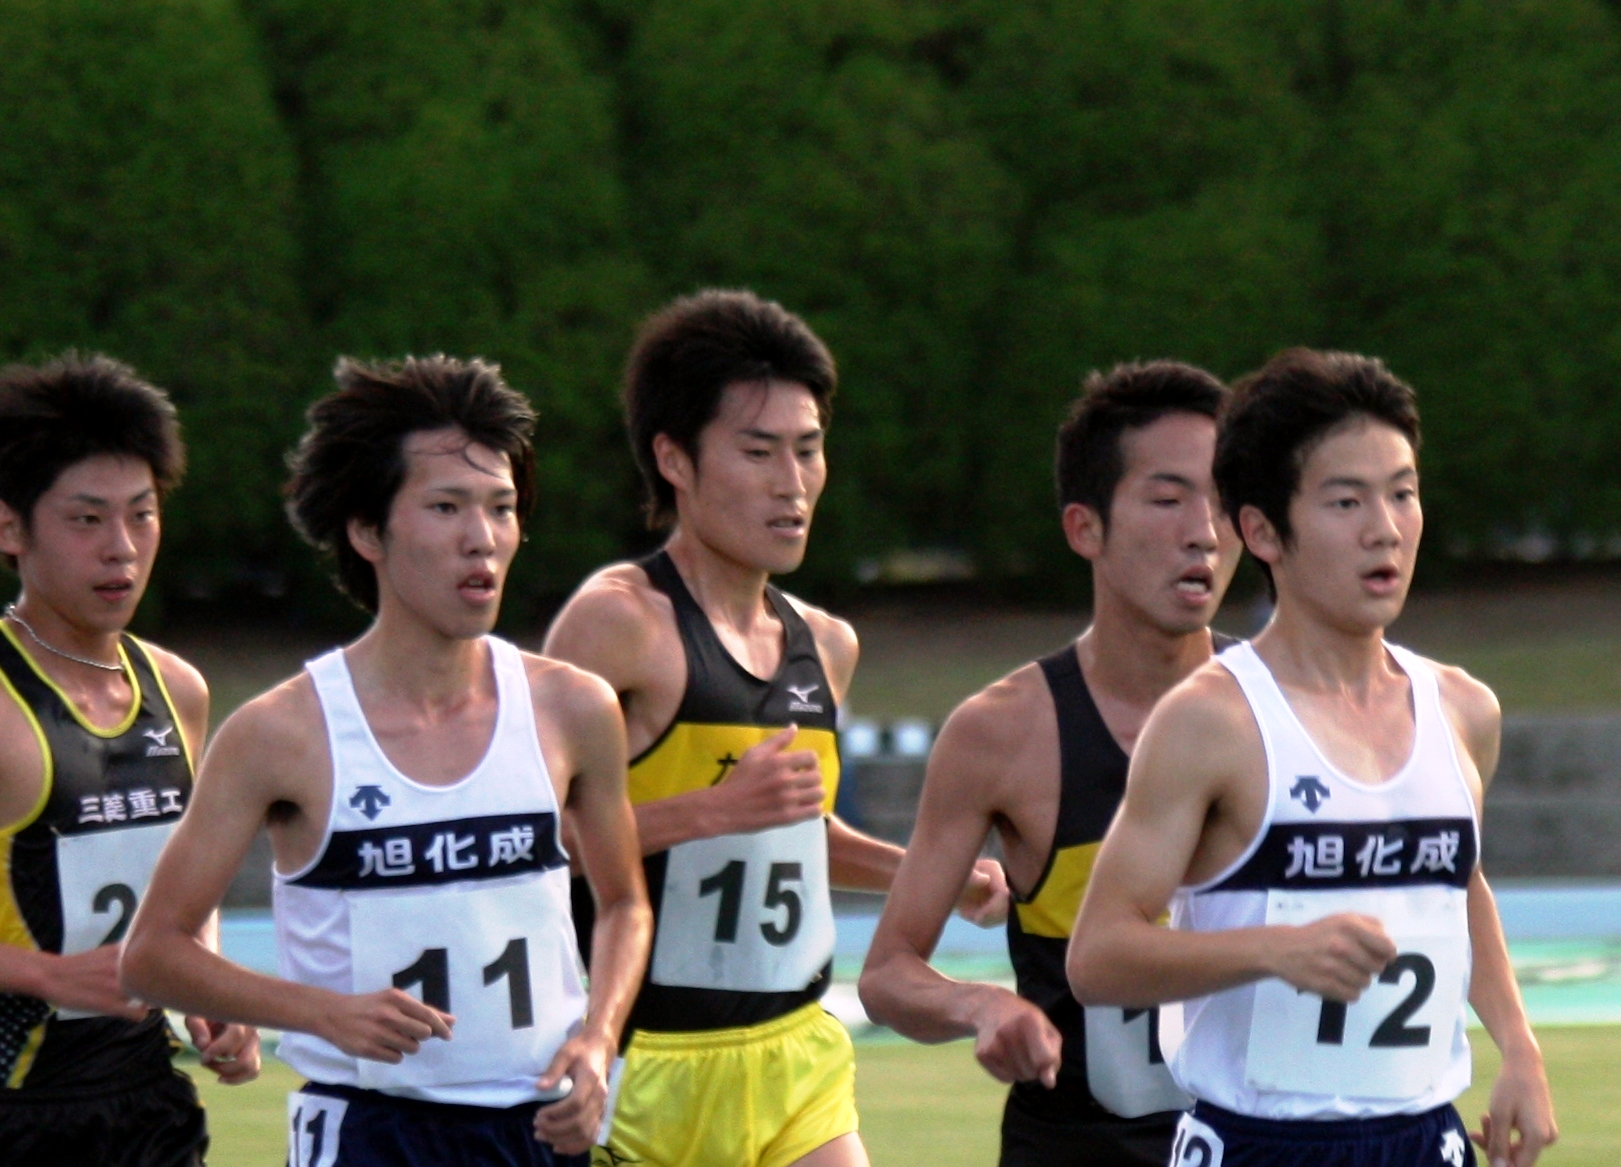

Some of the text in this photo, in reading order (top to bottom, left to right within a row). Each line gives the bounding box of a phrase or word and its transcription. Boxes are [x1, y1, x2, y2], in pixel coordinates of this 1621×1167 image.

[358, 825, 535, 878] 旭化成
[1285, 830, 1460, 879] 旭化成
[699, 860, 803, 947] 15
[392, 937, 534, 1030] 11
